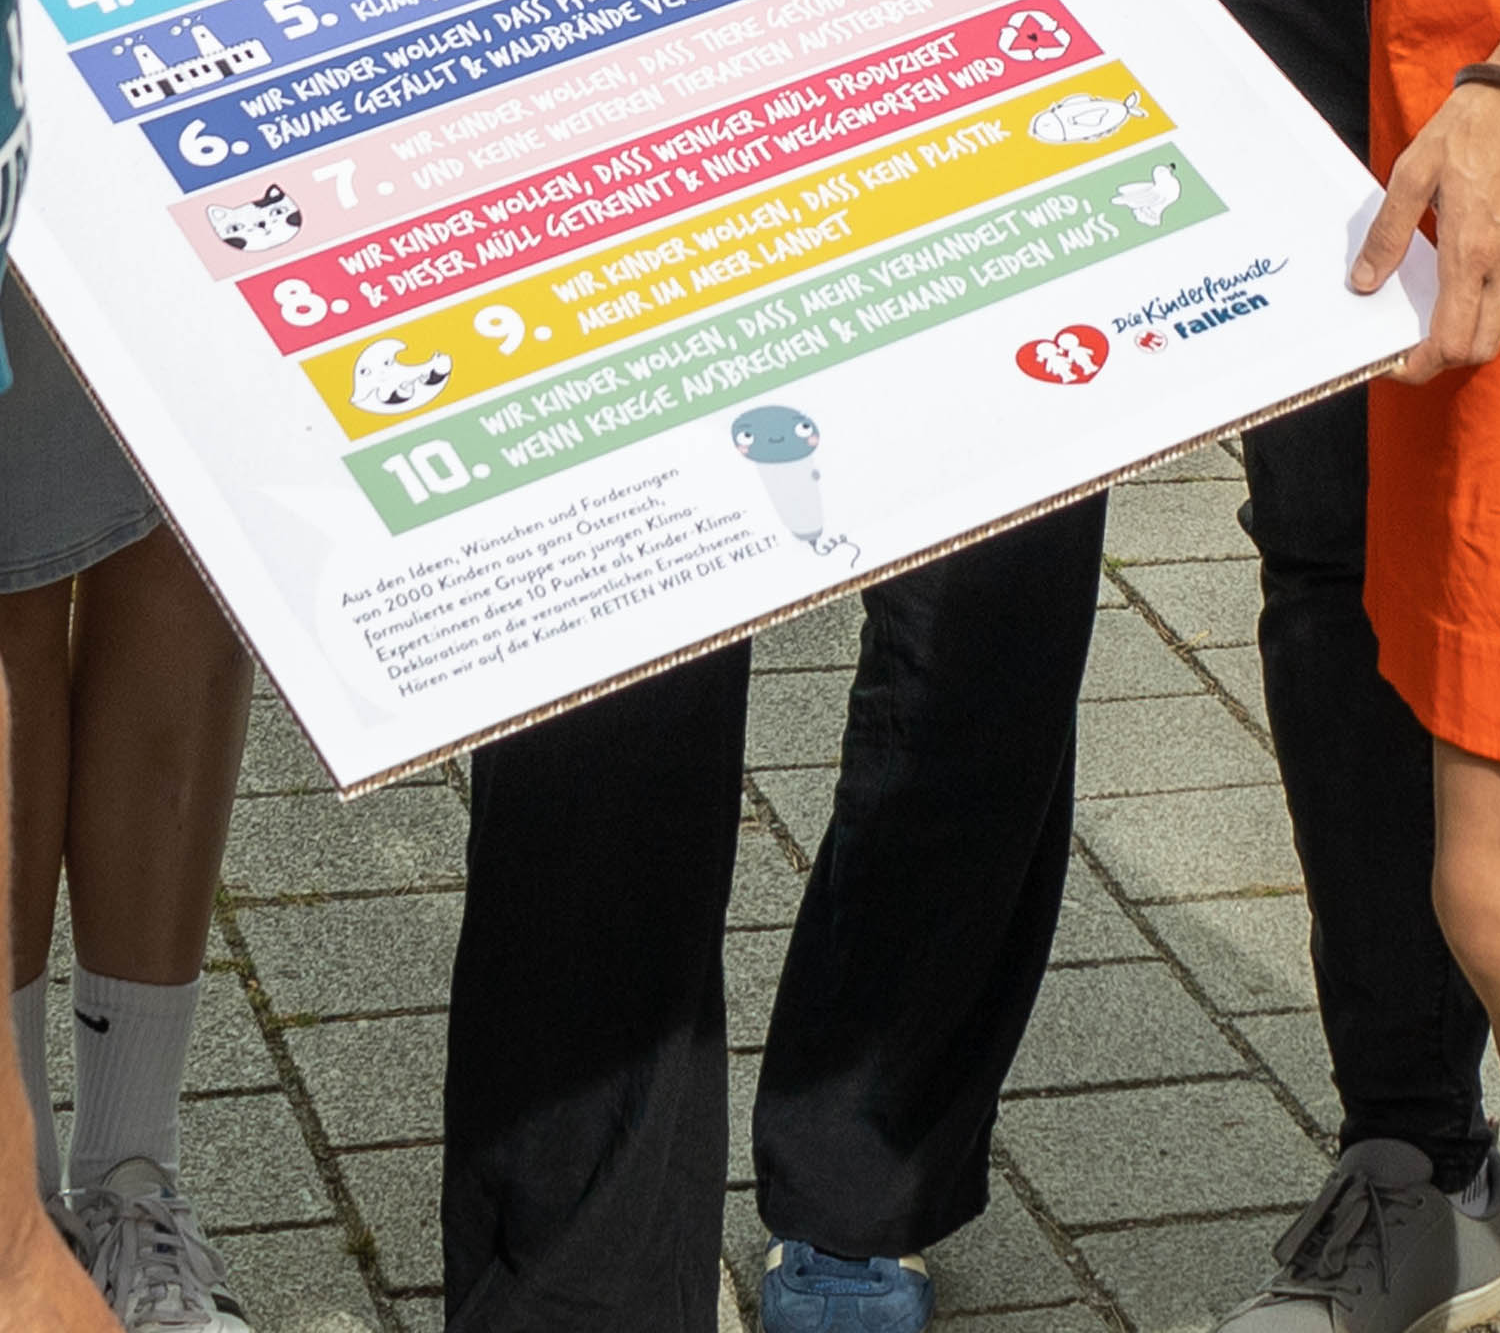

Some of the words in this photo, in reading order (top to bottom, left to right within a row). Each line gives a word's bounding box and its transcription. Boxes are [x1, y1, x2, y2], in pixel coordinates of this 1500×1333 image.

[239, 87, 295, 118] WIR
[291, 55, 387, 101] KINDER
[382, 19, 492, 69] WOLLEN,
[257, 100, 352, 150] BÄUME
[354, 58, 457, 114] GEFÄLLT
[459, 55, 488, 79] &
[485, 0, 642, 68] WALDBRÄNDE
[390, 130, 445, 160] WIR
[439, 98, 535, 144] KINDER
[637, 38, 696, 75] DASS
[690, 15, 766, 53] TIERE
[411, 158, 464, 190] UND
[467, 127, 546, 169] KEINE
[543, 83, 665, 142] WEITEREN
[662, 38, 794, 97] TIERARTEN
[178, 119, 249, 166] 6.
[311, 158, 394, 209] 7.
[338, 242, 395, 275] WIR
[389, 209, 487, 258] KINDER
[481, 171, 593, 223] WOLLEN,
[592, 146, 653, 184] DASS
[650, 109, 766, 163] WENIGER
[763, 86, 827, 125] MÜLL
[825, 31, 959, 100] PRODUZIERT
[359, 281, 388, 308] &
[386, 249, 477, 295] DIESER
[475, 225, 542, 266] MÜLL
[546, 170, 673, 237] GETRENNT
[675, 166, 704, 192] &
[701, 134, 772, 182] NICHT
[772, 73, 950, 154] WEGGEWORFEN
[947, 56, 1005, 89] WIRD
[551, 270, 607, 304] WIR
[600, 236, 698, 286] KINDER
[691, 198, 802, 251] WOLLEN,
[799, 172, 860, 211] DASS
[857, 151, 919, 190] KEIN
[917, 119, 1011, 168] PLASTIK
[577, 290, 654, 335] MEHR
[650, 276, 687, 306] IM
[689, 249, 764, 293] MEER
[757, 208, 852, 265] LANDET
[273, 278, 349, 326] 8.
[473, 304, 553, 355] 9.
[479, 401, 536, 435] WIR
[530, 366, 630, 417] KINDER
[623, 324, 737, 381] WOLLEN,
[735, 298, 798, 338] DASS
[799, 273, 875, 317] MEHR
[868, 209, 1021, 287] VERHANDELT
[1020, 194, 1092, 228] WIRD,
[500, 418, 584, 467] WENN
[584, 384, 678, 436] KRIEGE
[681, 324, 829, 402] AUSBRECHEN
[829, 316, 858, 344] &
[855, 275, 967, 333] NIEMAND
[969, 237, 1055, 287] LEIDEN
[1057, 212, 1119, 255] MUSS
[1111, 312, 1143, 334] Die
[1141, 258, 1287, 325] Kinderfreunde
[1173, 292, 1269, 339] falken
[382, 439, 491, 504] 10.
